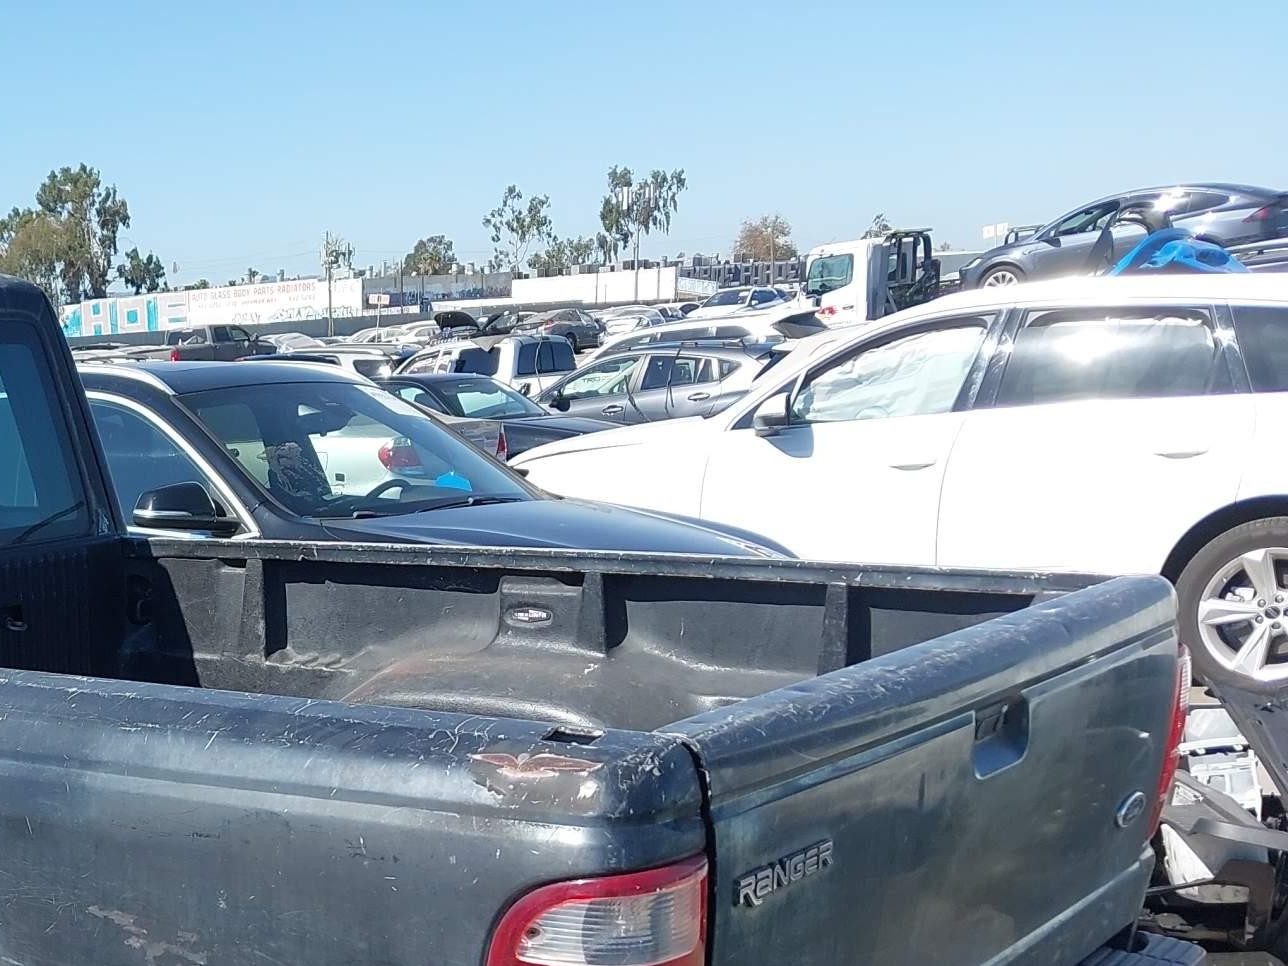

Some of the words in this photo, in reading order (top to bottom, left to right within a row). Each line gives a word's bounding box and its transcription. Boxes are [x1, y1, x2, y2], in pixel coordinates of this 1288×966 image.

[233, 288, 250, 298] BODY
[253, 286, 274, 296] PARTS
[277, 282, 316, 294] RADIATORS
[734, 840, 833, 906] RANGER
